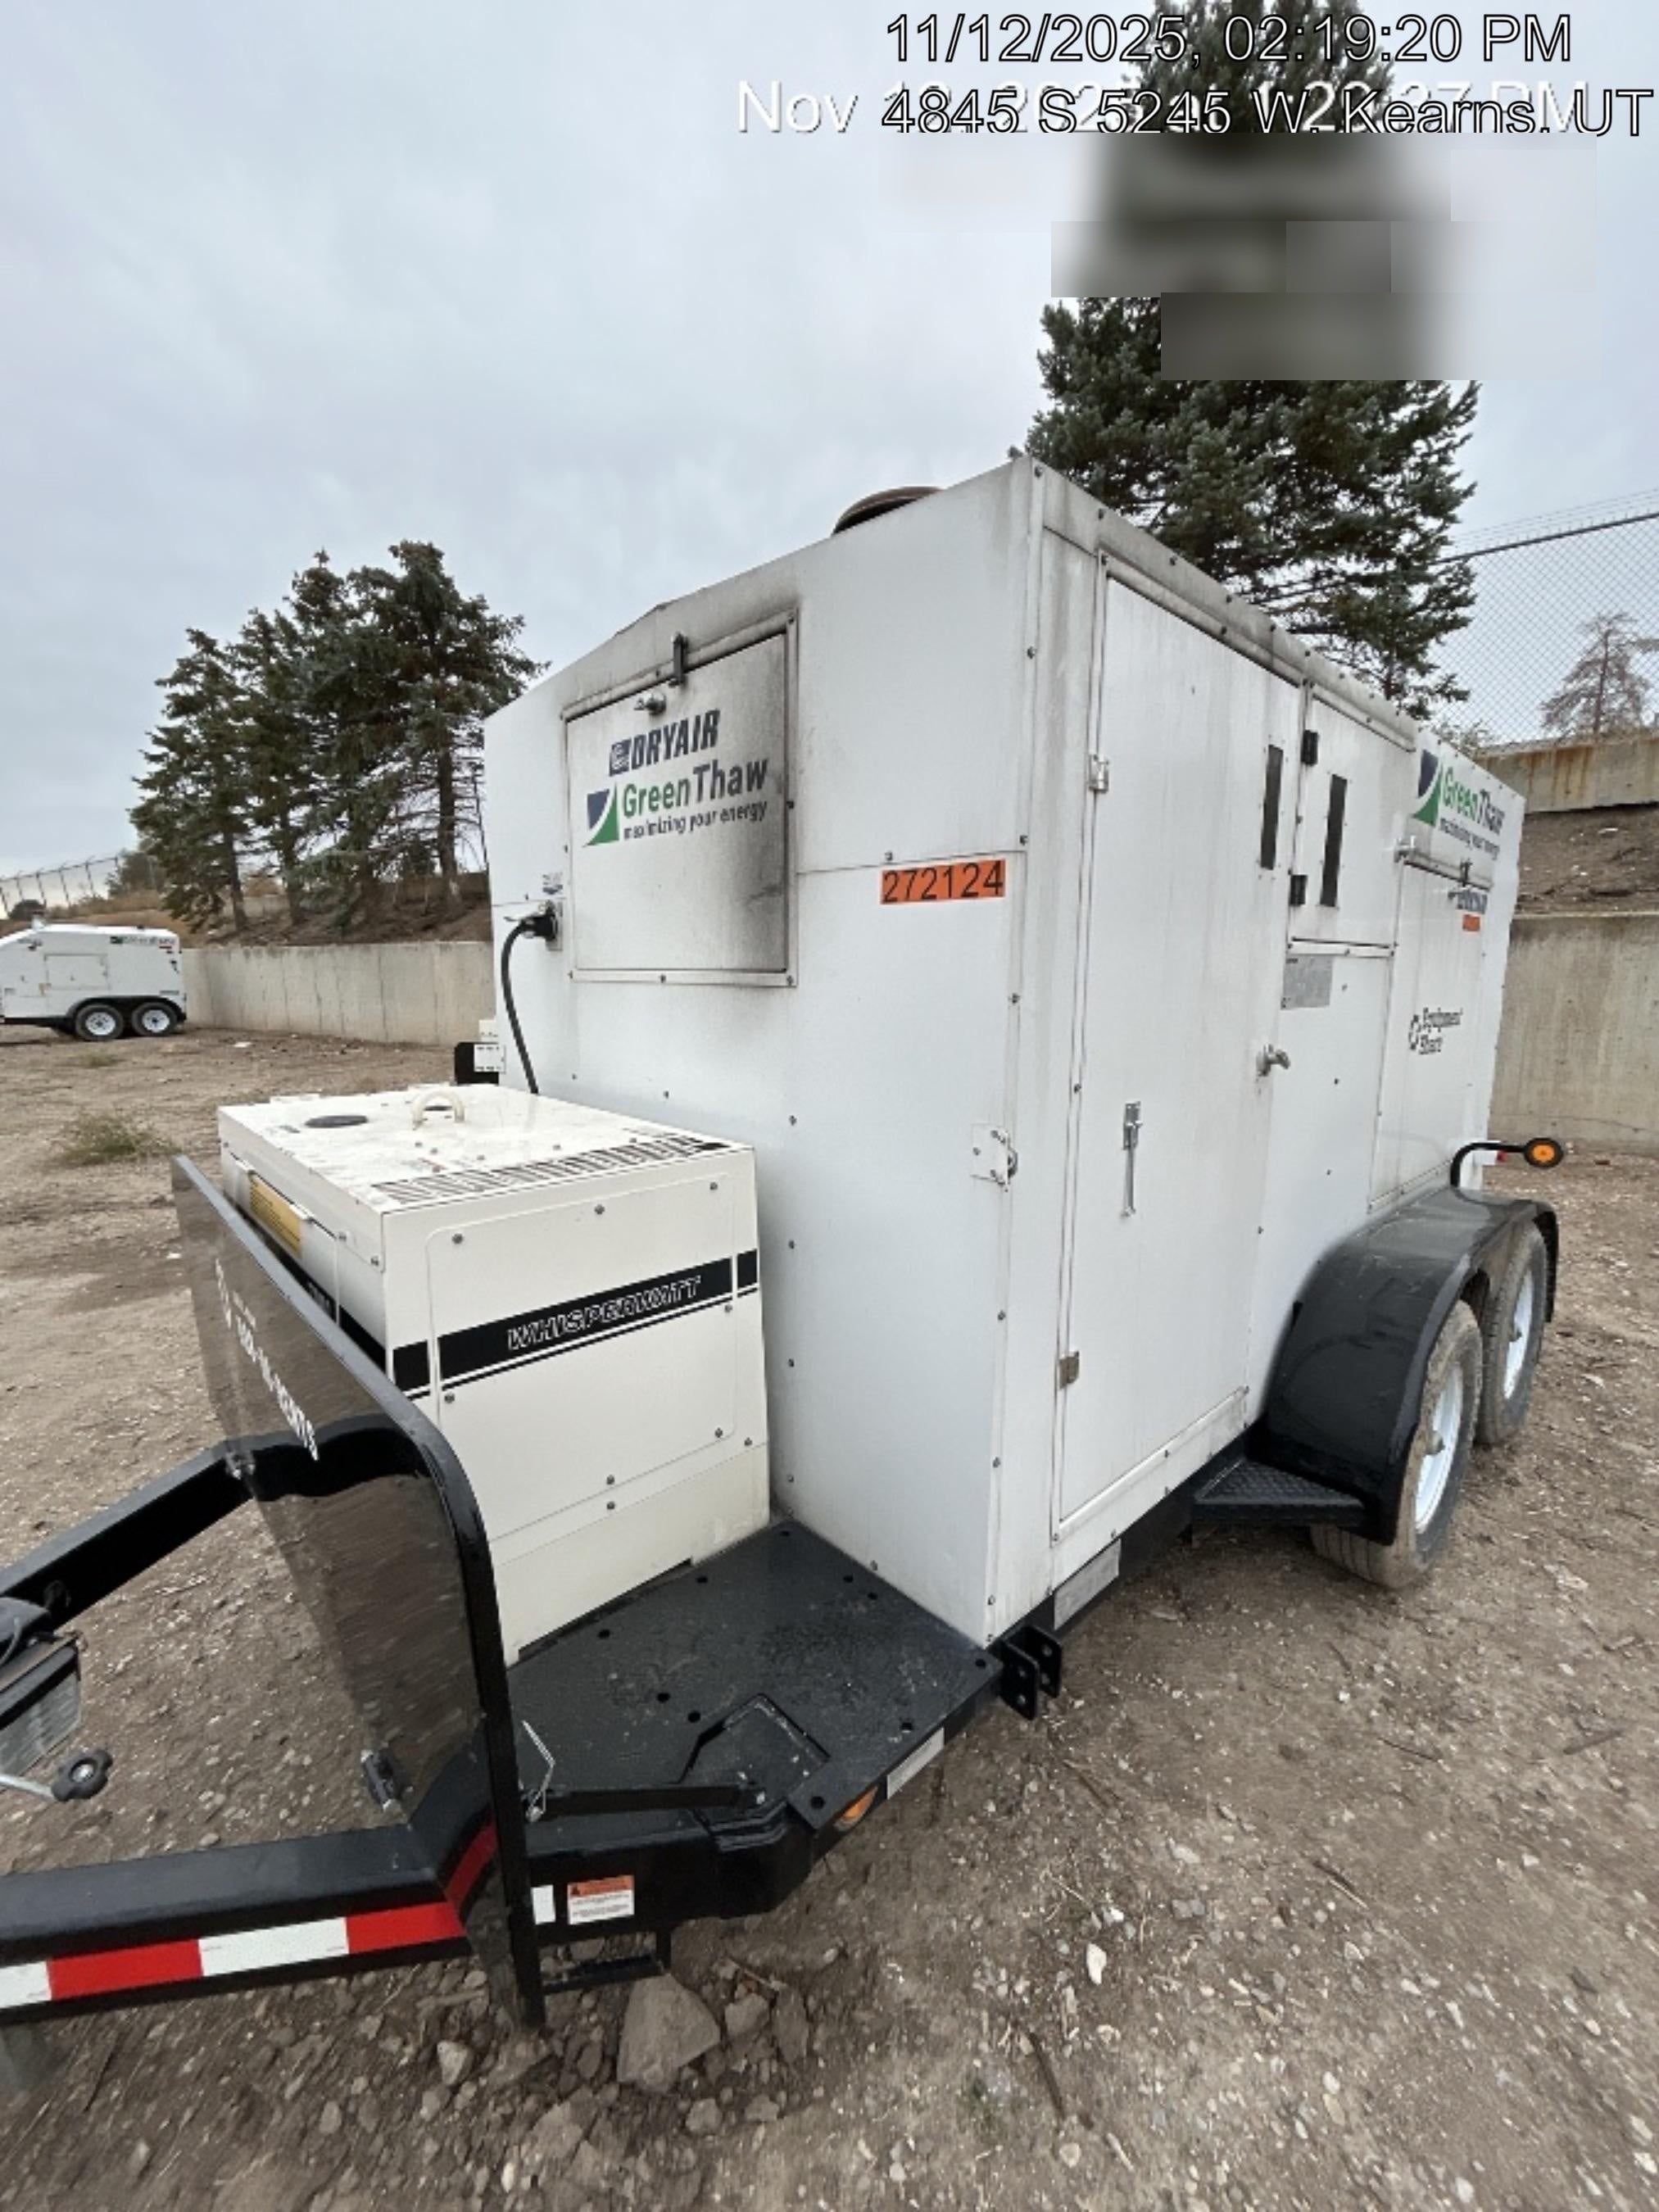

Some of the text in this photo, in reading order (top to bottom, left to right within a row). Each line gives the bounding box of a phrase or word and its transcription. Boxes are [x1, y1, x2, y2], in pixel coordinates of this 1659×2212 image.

[632, 709, 720, 770] DRYAIR
[623, 759, 768, 819] GreenThaw
[691, 809, 718, 832] your
[720, 800, 768, 824] energy
[882, 859, 1004, 904] 272124
[508, 1274, 702, 1351] WHISPERWATT
